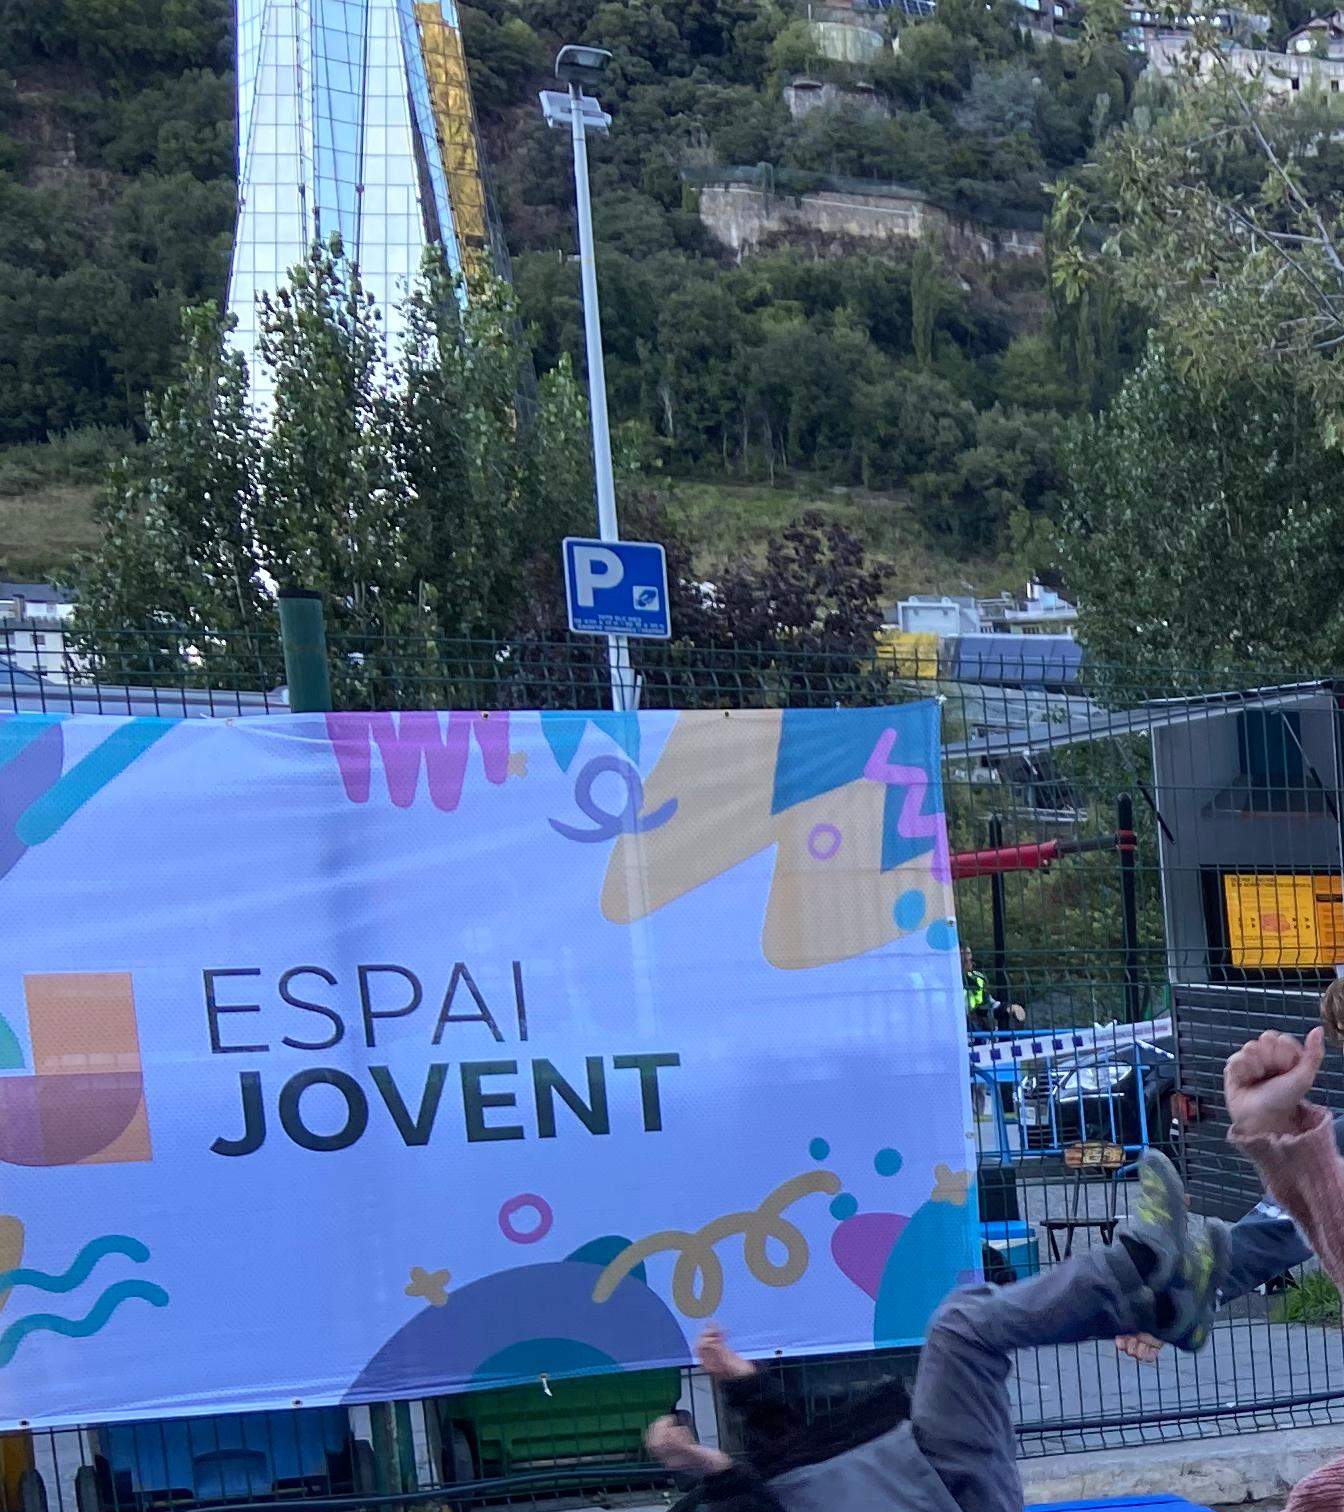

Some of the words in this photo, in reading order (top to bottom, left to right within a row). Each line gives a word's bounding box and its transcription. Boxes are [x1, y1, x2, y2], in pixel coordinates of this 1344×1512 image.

[573, 546, 624, 607] P
[203, 961, 528, 1054] ESPAI
[209, 1052, 681, 1158] JOVENT
